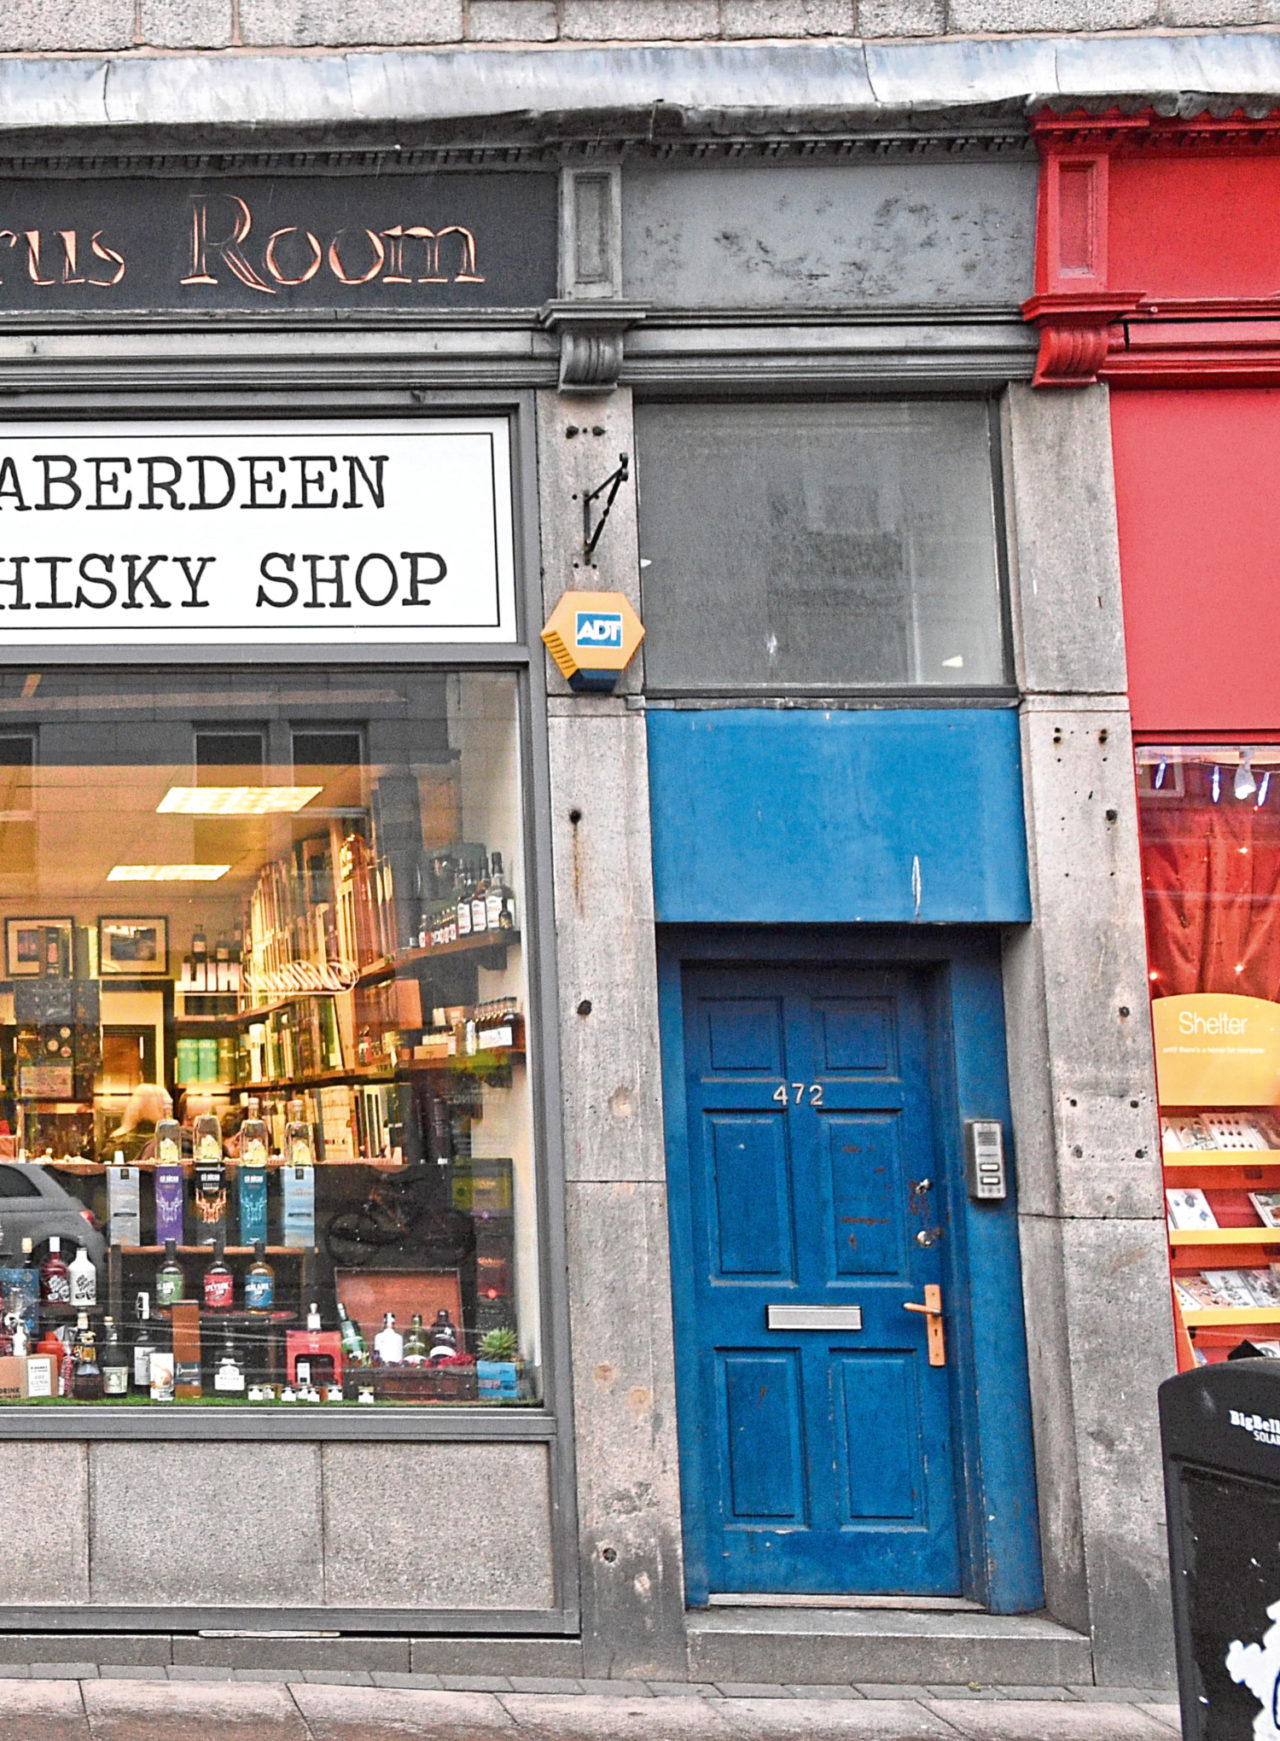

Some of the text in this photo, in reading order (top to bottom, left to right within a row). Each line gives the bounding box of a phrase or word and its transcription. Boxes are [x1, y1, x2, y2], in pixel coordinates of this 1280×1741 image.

[179, 193, 485, 294] Room
[256, 552, 449, 607] SHOP
[577, 620, 622, 641] ADT
[1178, 1011, 1249, 1034] Shelter
[773, 1083, 824, 1106] 472
